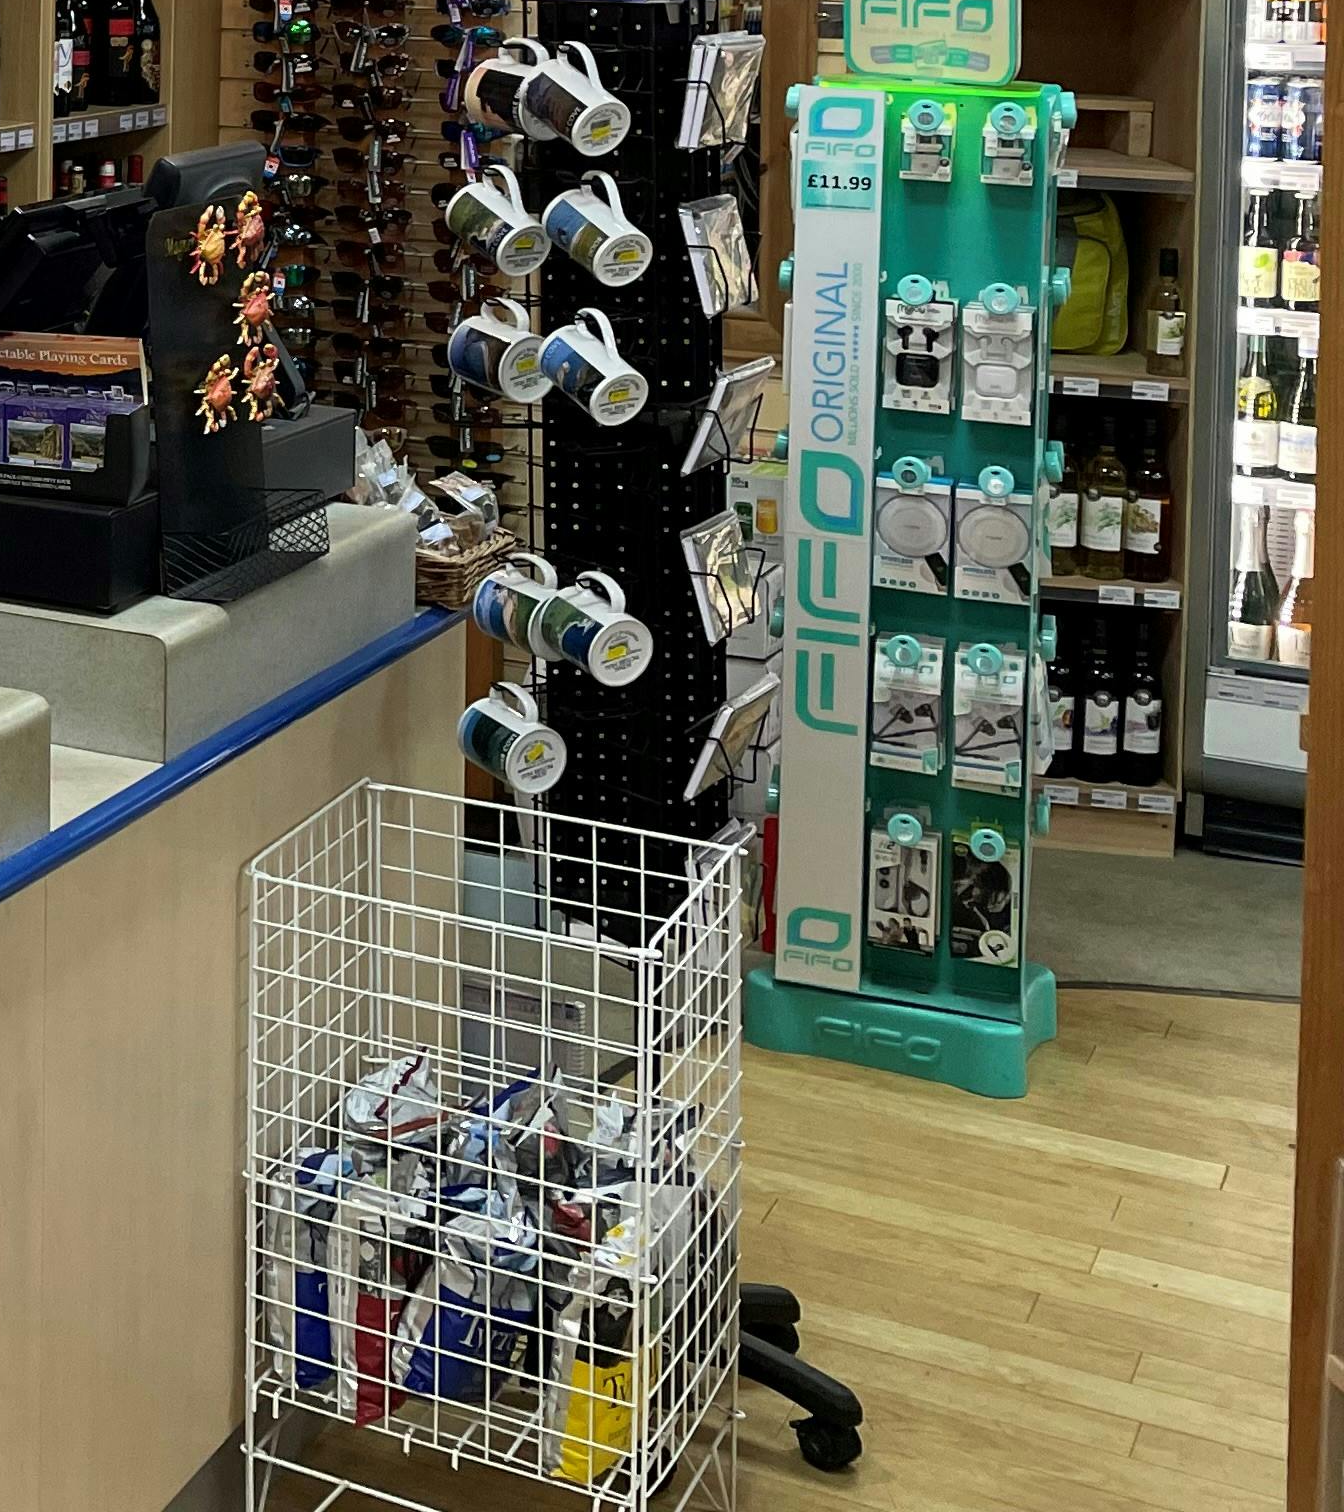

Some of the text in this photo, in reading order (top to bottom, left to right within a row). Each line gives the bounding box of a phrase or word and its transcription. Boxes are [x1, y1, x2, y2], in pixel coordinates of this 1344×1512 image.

[566, 106, 583, 128] COVE
[804, 140, 876, 158] FIFO
[807, 173, 873, 192] £11.99
[38, 349, 88, 367] Playing
[89, 351, 130, 368] Cards
[810, 261, 849, 443] ORIGINAL
[795, 450, 868, 737] FIFO
[783, 948, 854, 972] FIFO
